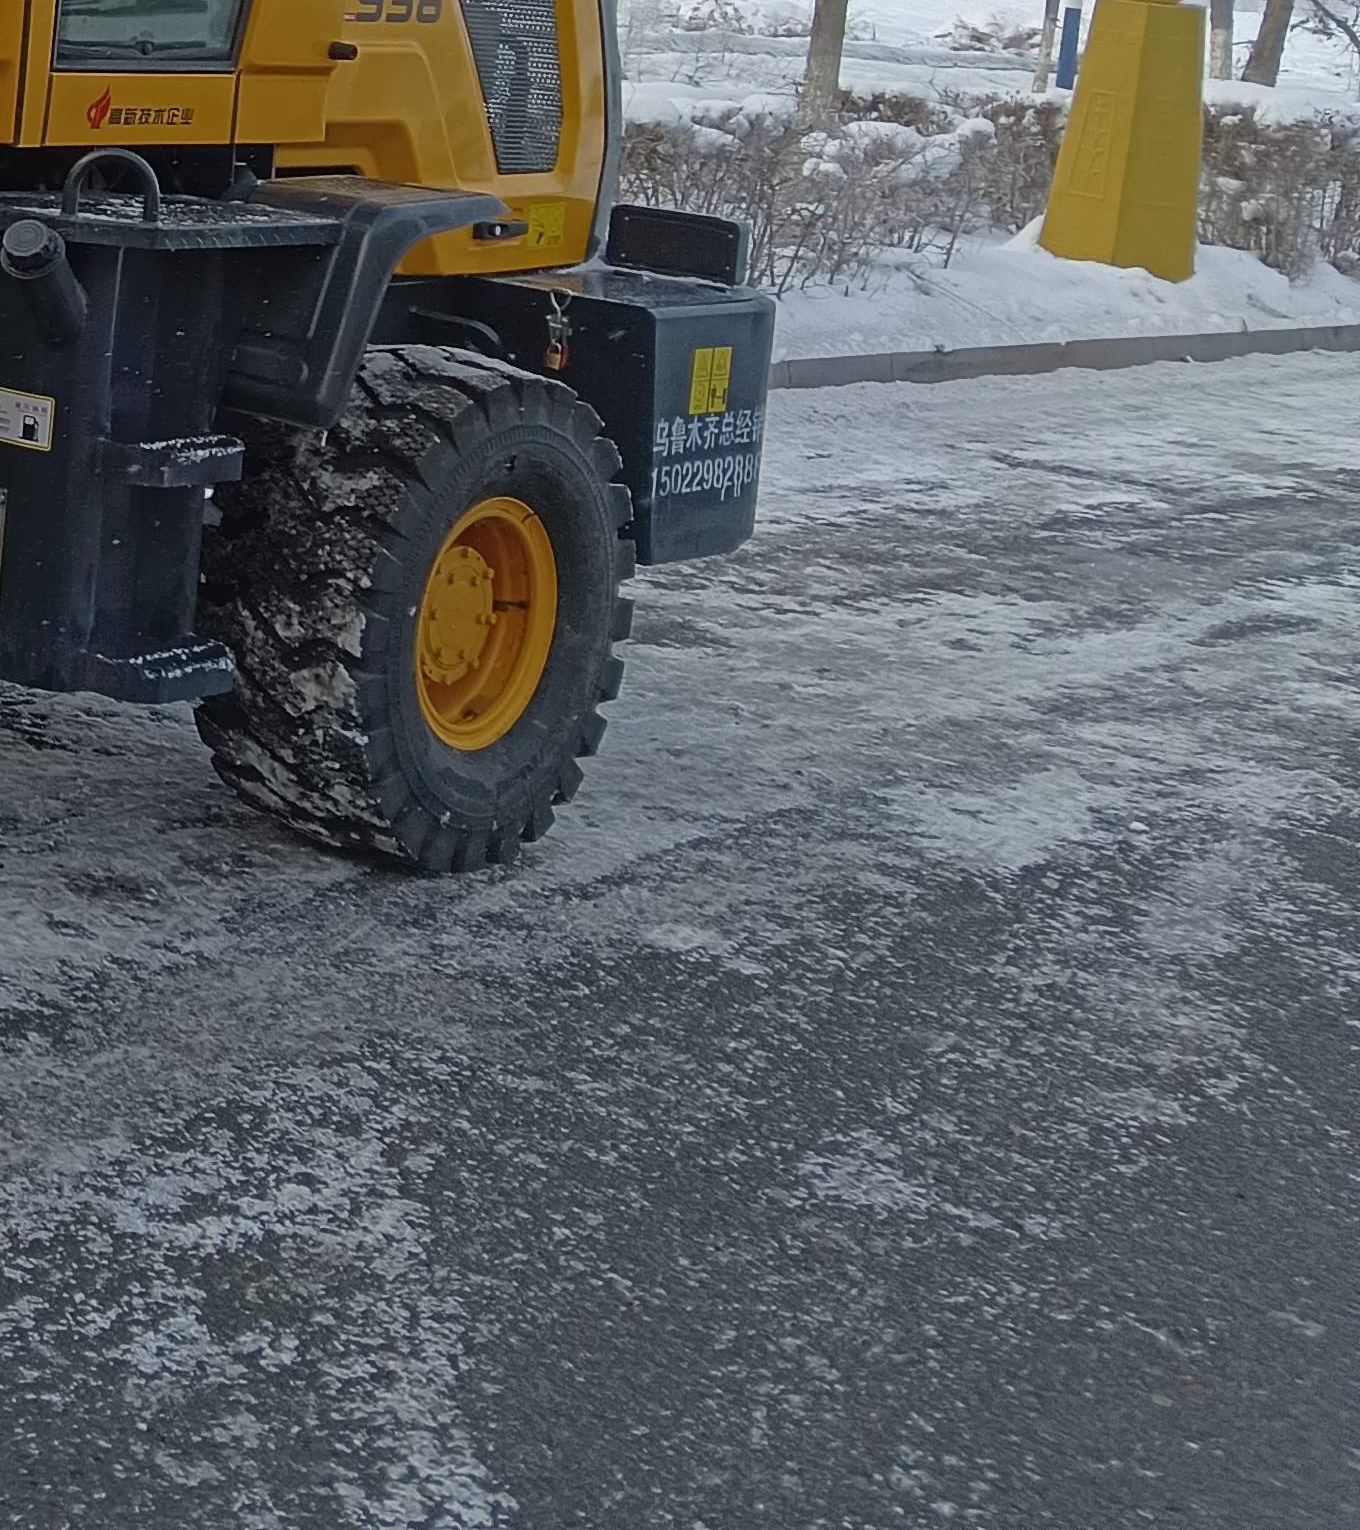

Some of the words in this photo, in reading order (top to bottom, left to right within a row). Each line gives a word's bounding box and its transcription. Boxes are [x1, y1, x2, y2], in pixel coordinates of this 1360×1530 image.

[108, 107, 194, 126] 高新技术企业
